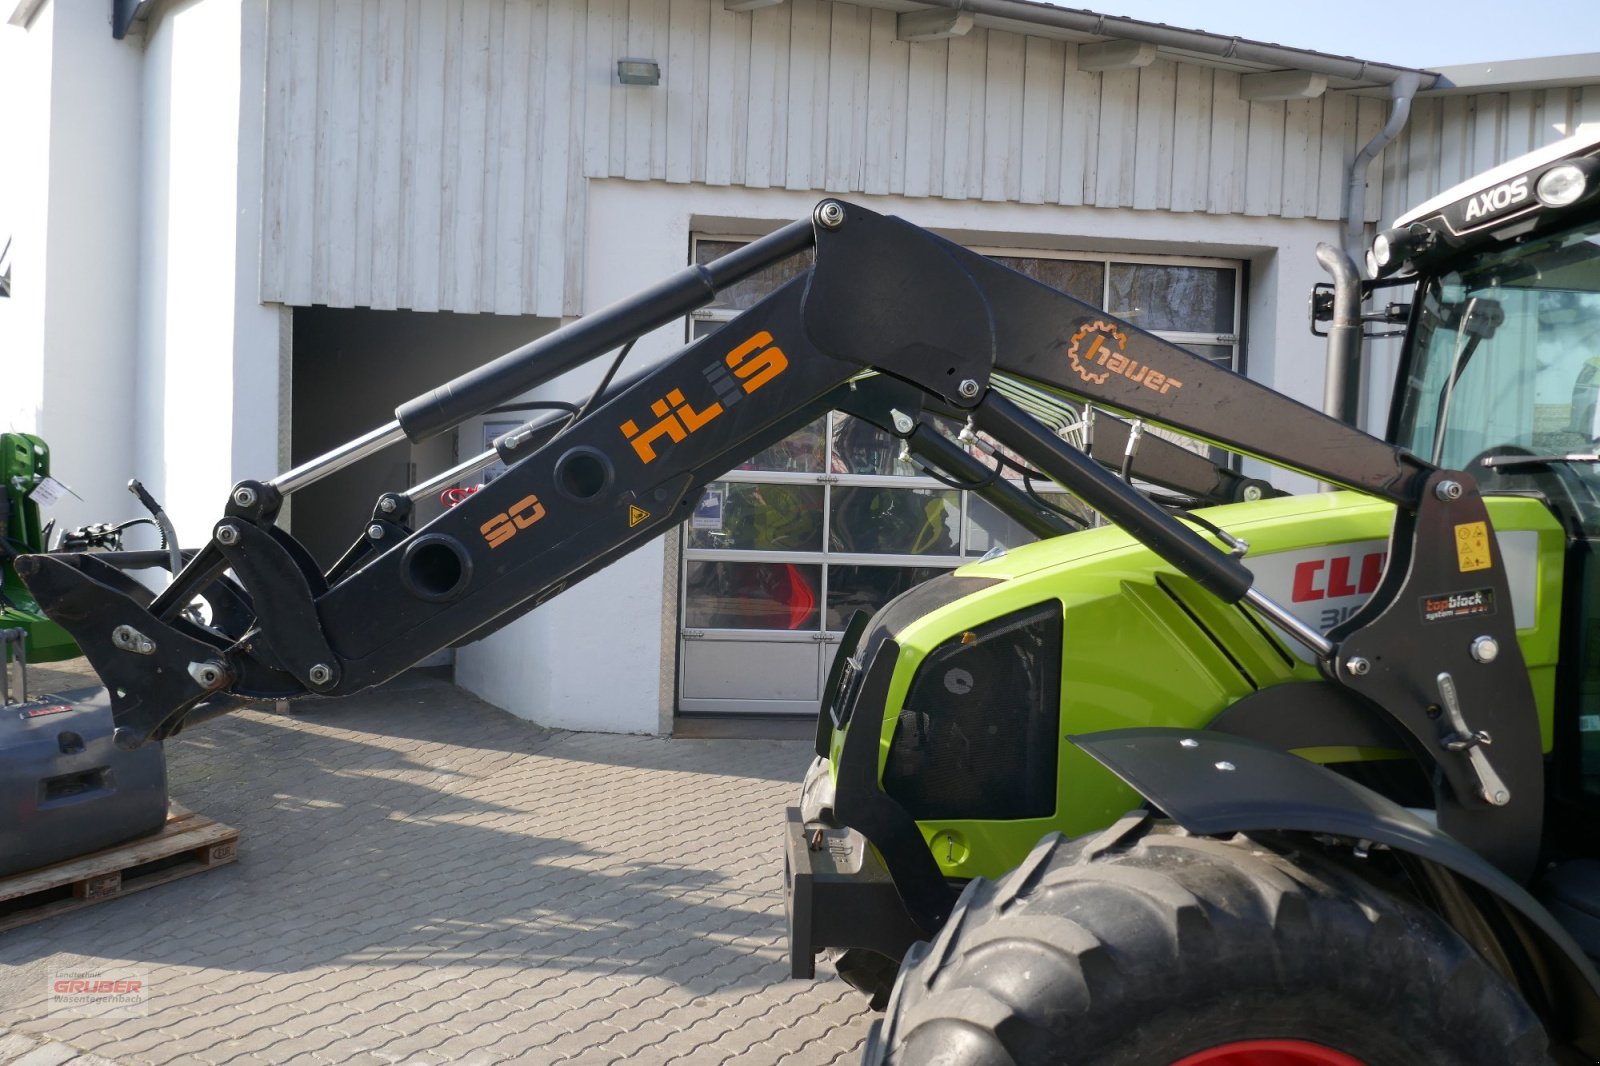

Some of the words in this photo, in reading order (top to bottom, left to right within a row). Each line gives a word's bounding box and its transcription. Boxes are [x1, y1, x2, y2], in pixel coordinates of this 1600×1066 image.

[1464, 176, 1528, 222] AXOS
[1084, 335, 1183, 394] hauer
[1425, 591, 1483, 613] topblock
